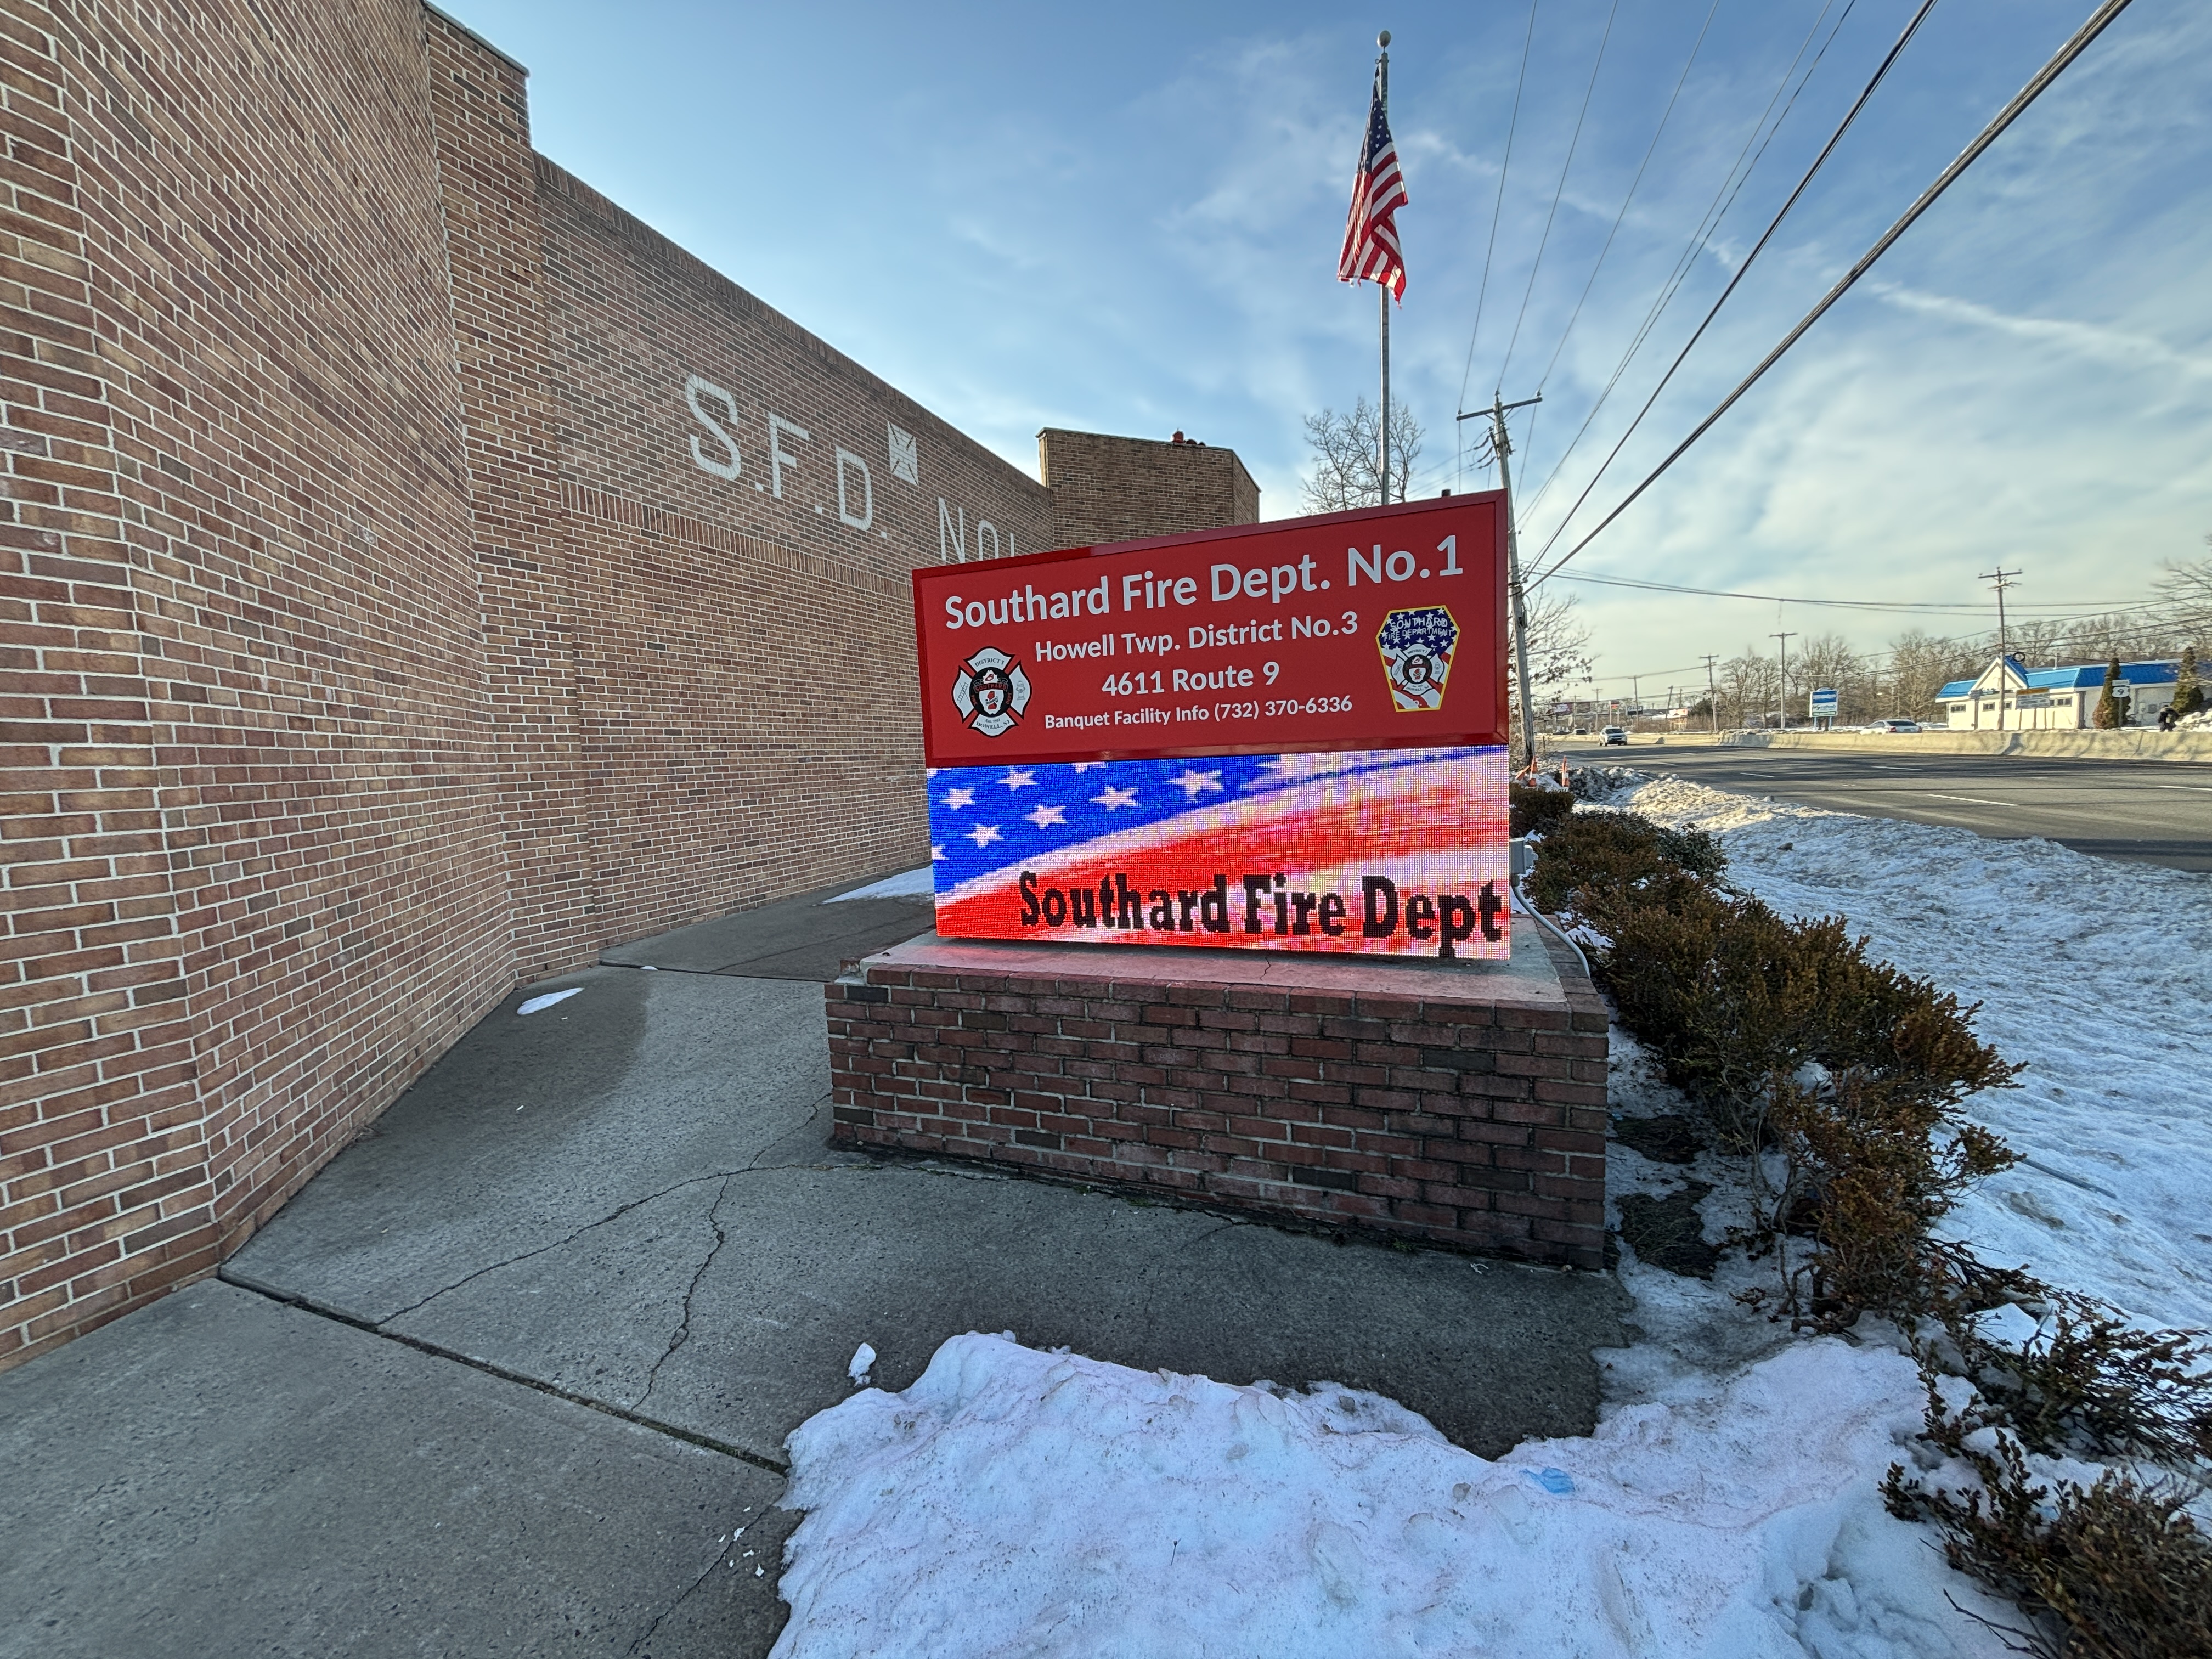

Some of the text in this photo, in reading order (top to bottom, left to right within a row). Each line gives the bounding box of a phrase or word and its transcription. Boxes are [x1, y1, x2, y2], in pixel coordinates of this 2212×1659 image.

[945, 535, 1463, 629] Southard Fire Dept. No.1
[1036, 611, 1358, 662] Howell Twp. District No.3
[1384, 627, 1452, 642] FIRE DEPARTMENT
[1390, 617, 1448, 631] SOUTHARD
[975, 658, 1001, 668] DISTRICT
[1102, 661, 1280, 696] 4611 Route 9
[975, 683, 1007, 692] SOUTHARD
[1045, 695, 1352, 730] Banquet Facility Info (732) 370-6336
[1019, 870, 1502, 958] Southard Fire Dept
